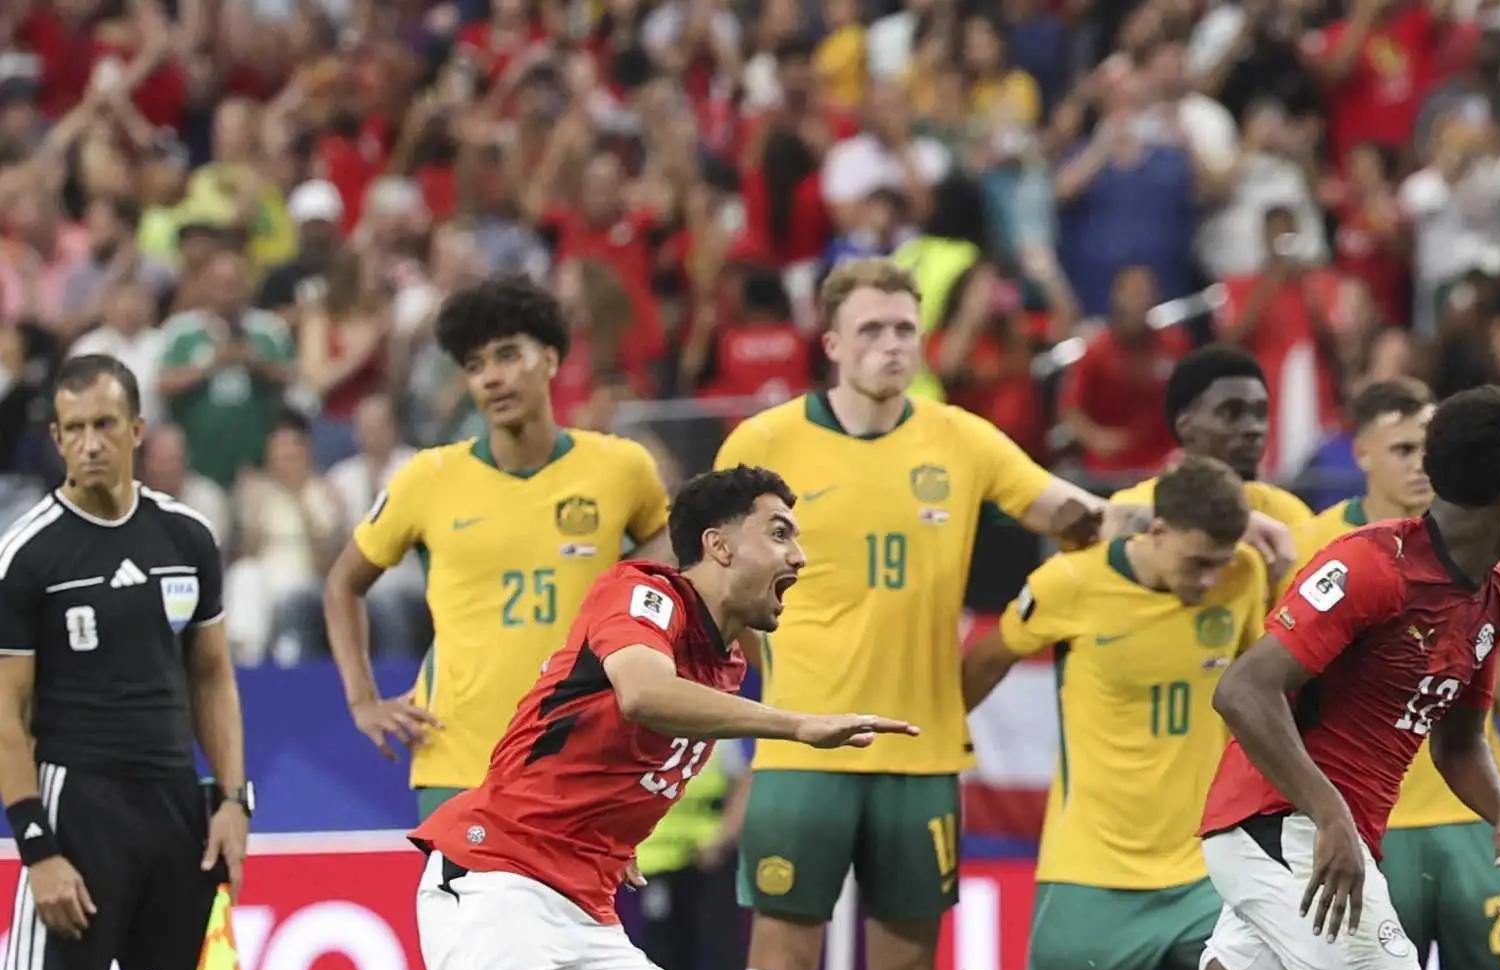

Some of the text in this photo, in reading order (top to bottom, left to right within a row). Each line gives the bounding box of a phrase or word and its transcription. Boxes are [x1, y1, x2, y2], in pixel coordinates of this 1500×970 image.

[866, 532, 907, 590] 19
[501, 569, 557, 627] 25
[1149, 680, 1191, 737] 10
[1394, 675, 1459, 736] 12
